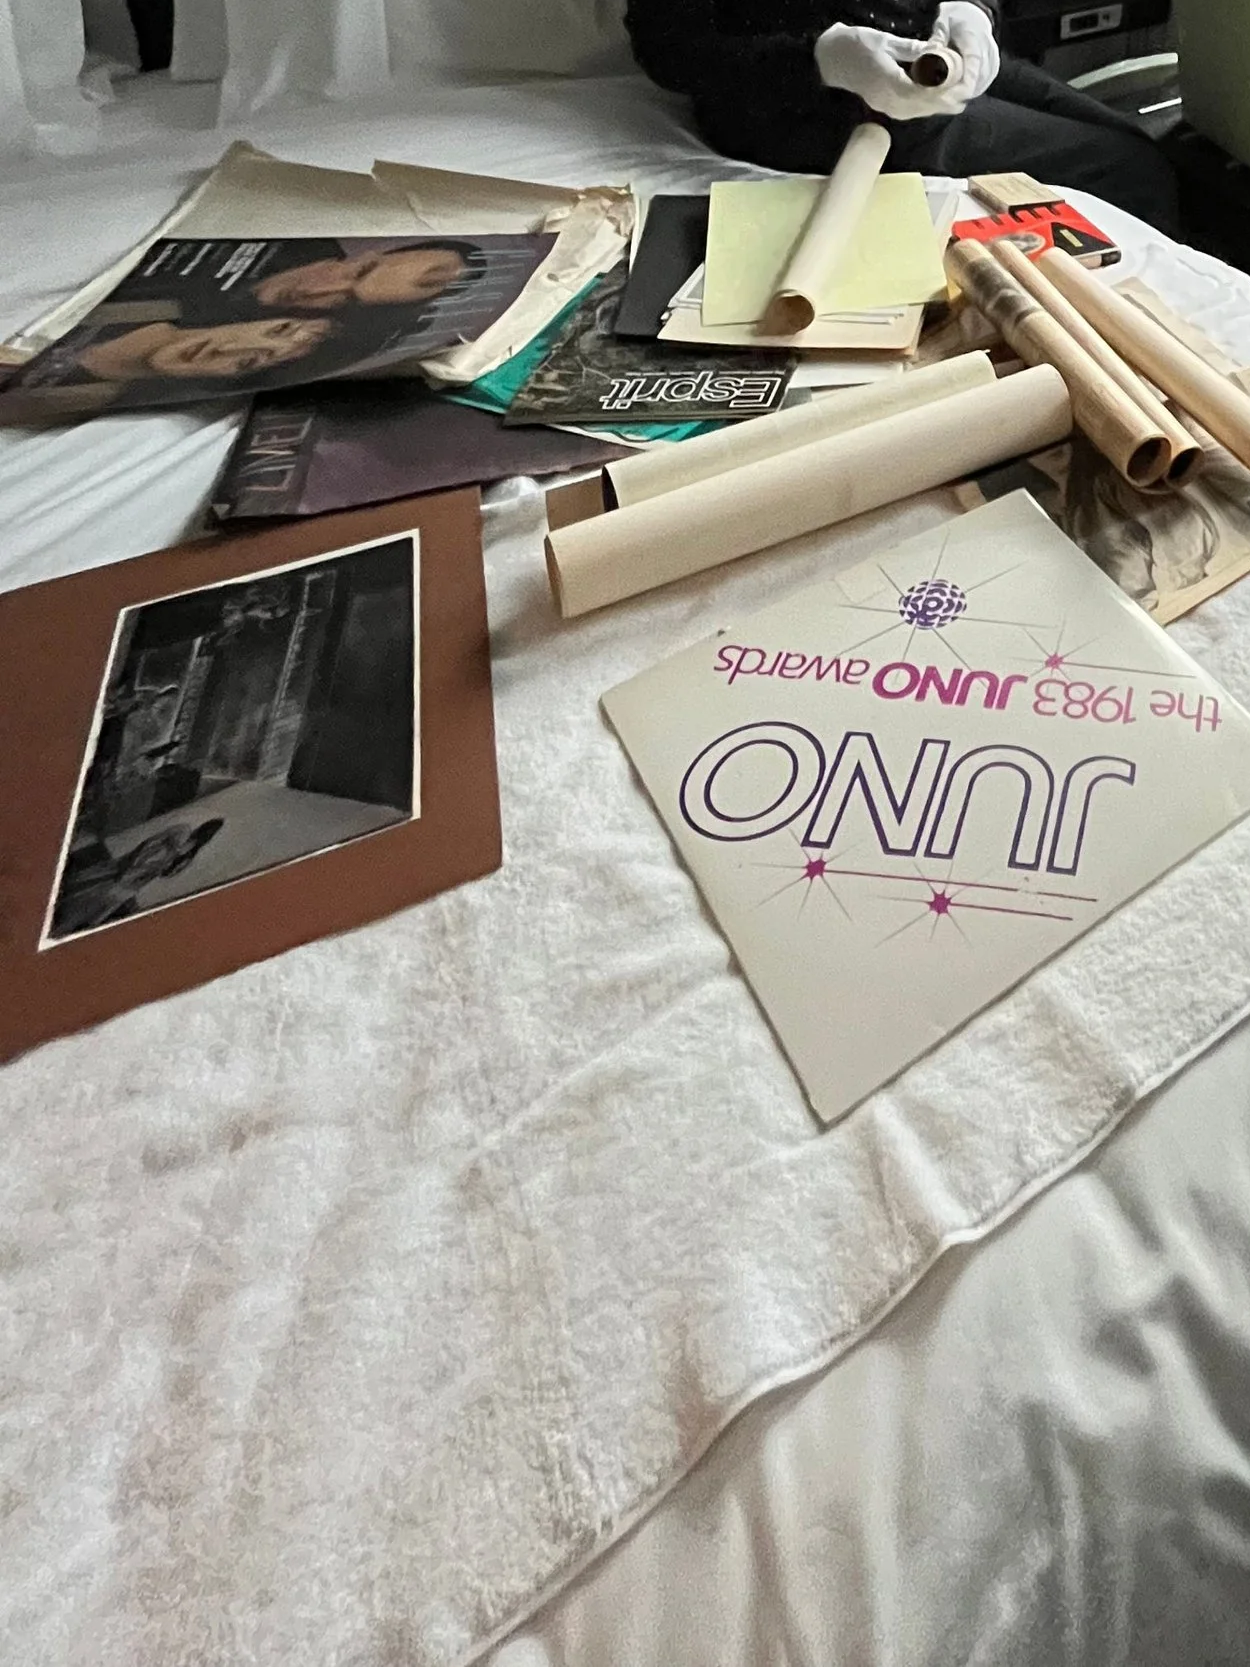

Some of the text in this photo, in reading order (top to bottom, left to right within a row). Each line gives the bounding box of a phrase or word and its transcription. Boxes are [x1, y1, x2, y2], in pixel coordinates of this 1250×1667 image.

[599, 371, 782, 410] Esprit
[713, 645, 1223, 733] the 1983 JUNO awards
[679, 720, 1137, 875] JUNO
